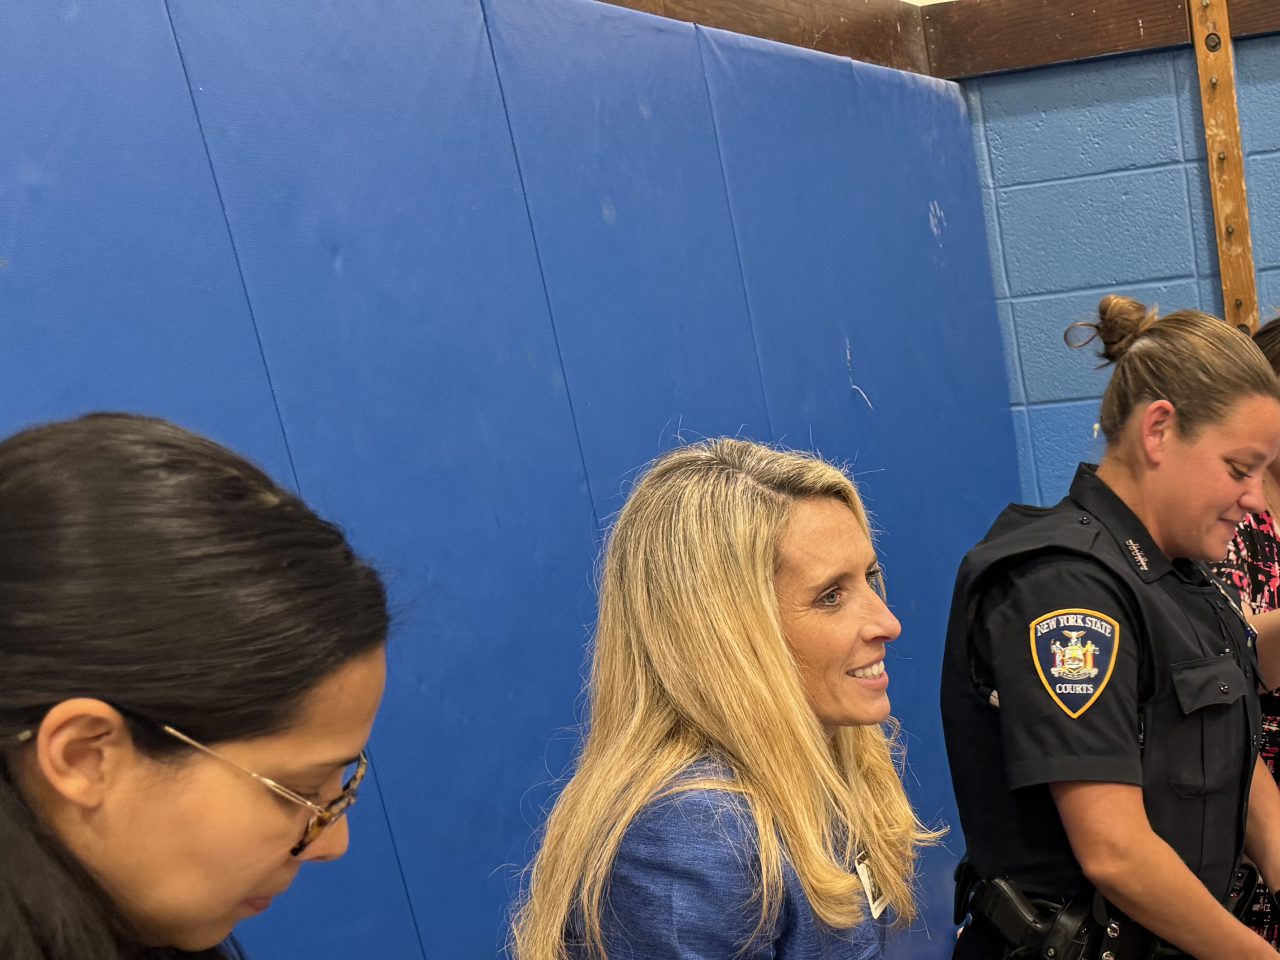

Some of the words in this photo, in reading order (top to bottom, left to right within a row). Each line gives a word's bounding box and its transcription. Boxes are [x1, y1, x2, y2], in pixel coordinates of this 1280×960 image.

[1036, 618, 1057, 636] NEW
[1058, 614, 1084, 626] YORK
[1085, 616, 1112, 637] STATE
[1055, 683, 1094, 694] COURTS
